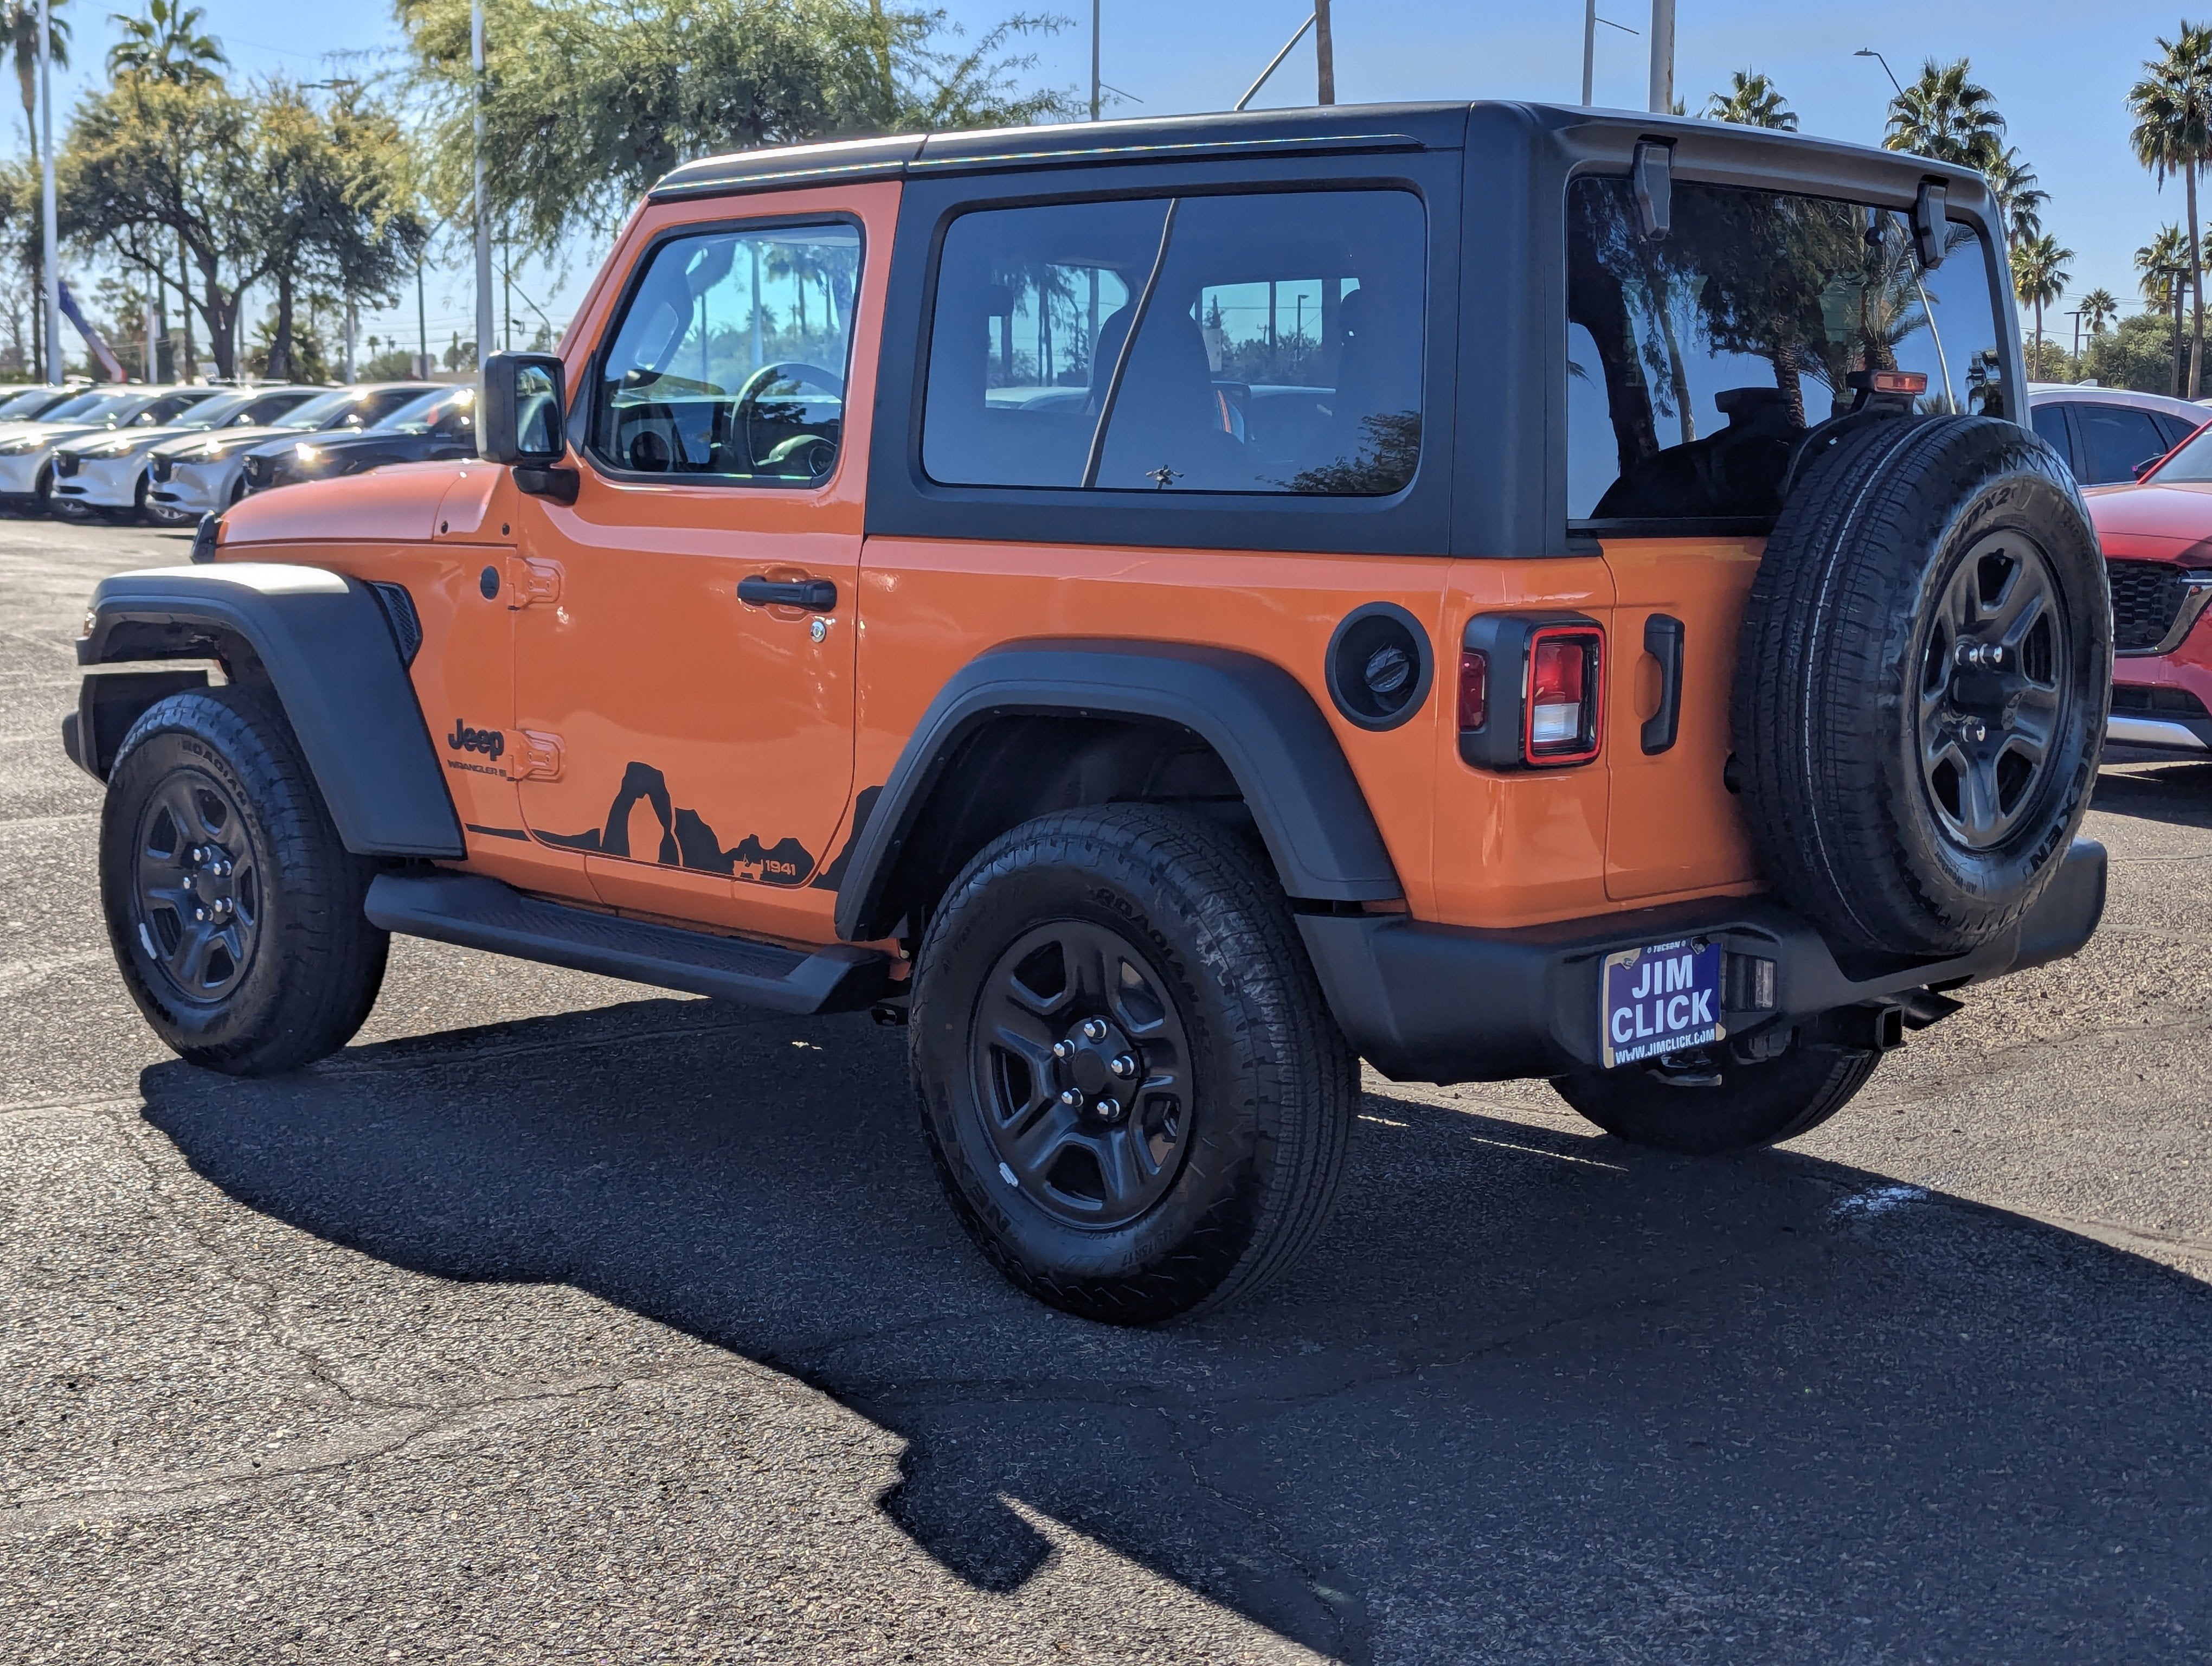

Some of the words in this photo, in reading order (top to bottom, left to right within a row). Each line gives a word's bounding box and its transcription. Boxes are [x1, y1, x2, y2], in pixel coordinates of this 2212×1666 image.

[448, 718, 504, 761] Jeep
[447, 759, 497, 776] WRANGLER
[766, 860, 796, 876] 1941
[1654, 941, 1681, 953] TUCSON
[1632, 954, 1693, 998] JIM
[1611, 988, 1713, 1043] CLICK
[1615, 1028, 1715, 1064] WWW.JIMCLICK.COM
